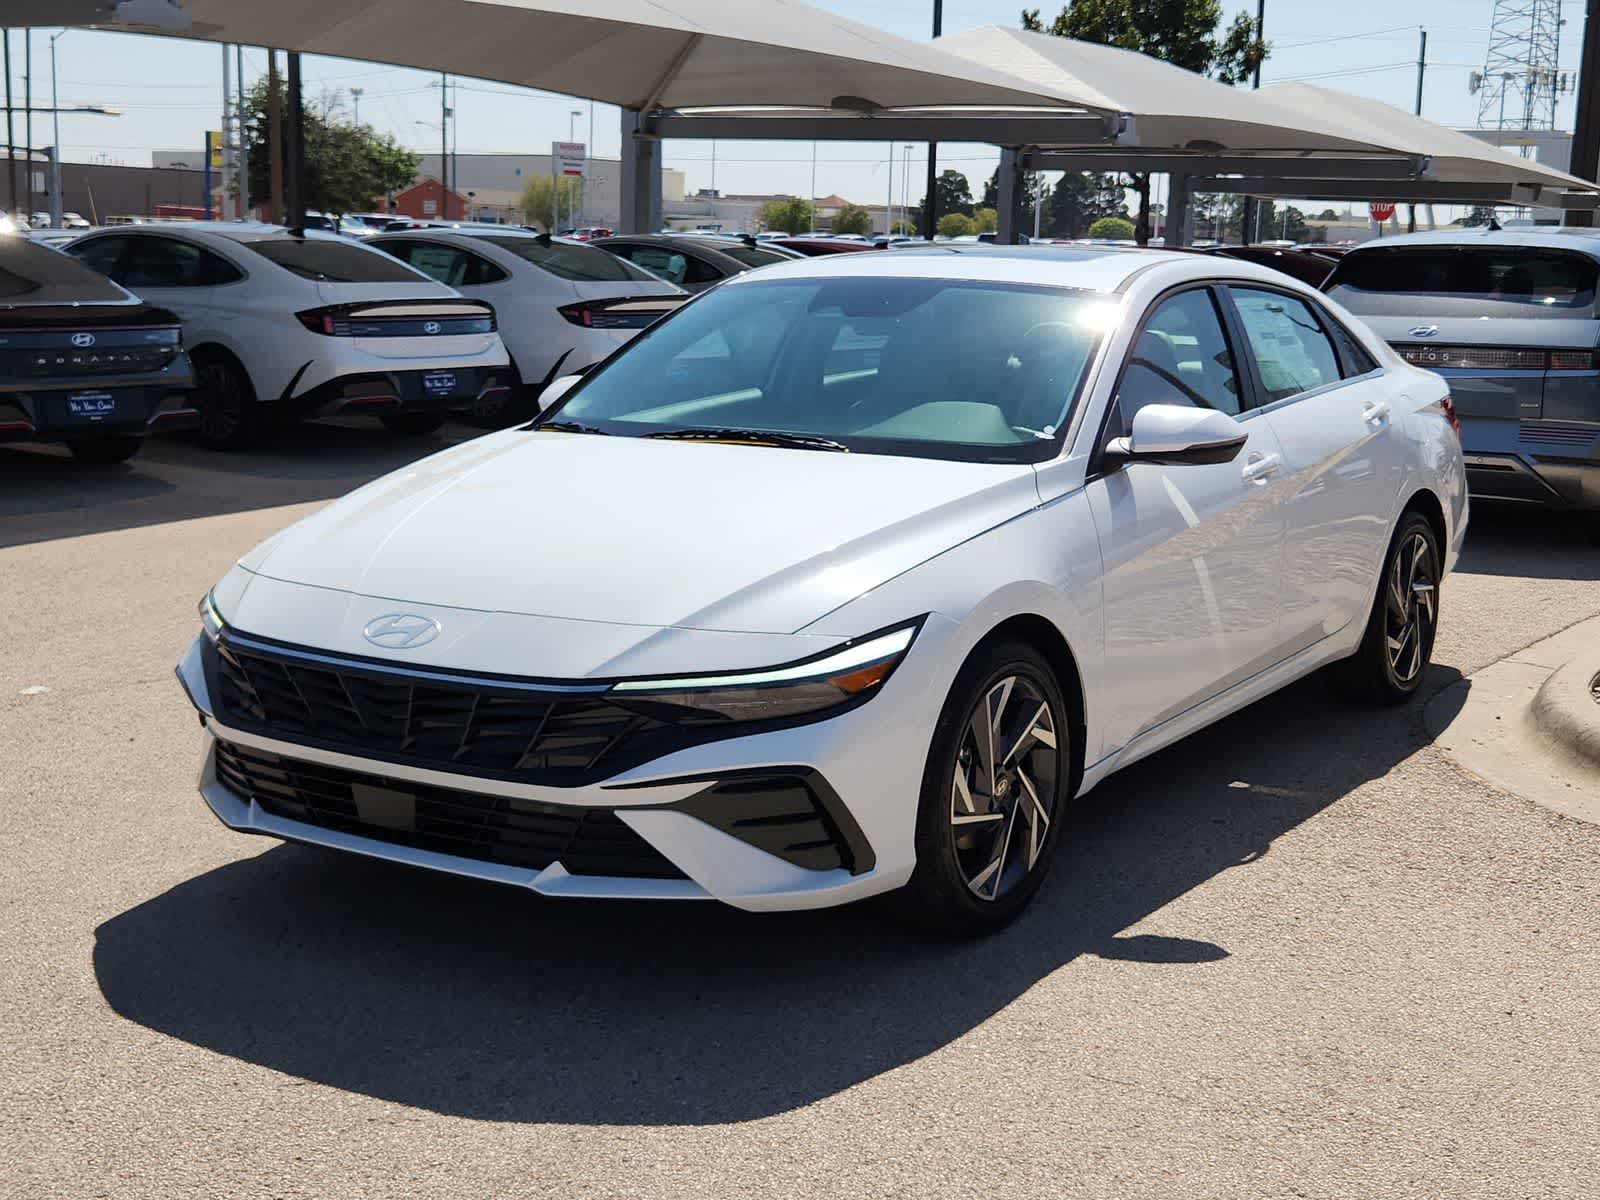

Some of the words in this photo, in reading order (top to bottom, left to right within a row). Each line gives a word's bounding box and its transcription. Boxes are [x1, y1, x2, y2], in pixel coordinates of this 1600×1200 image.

[1371, 202, 1394, 212] STOP
[37, 355, 132, 365] SONATA
[1442, 352, 1449, 361] 5
